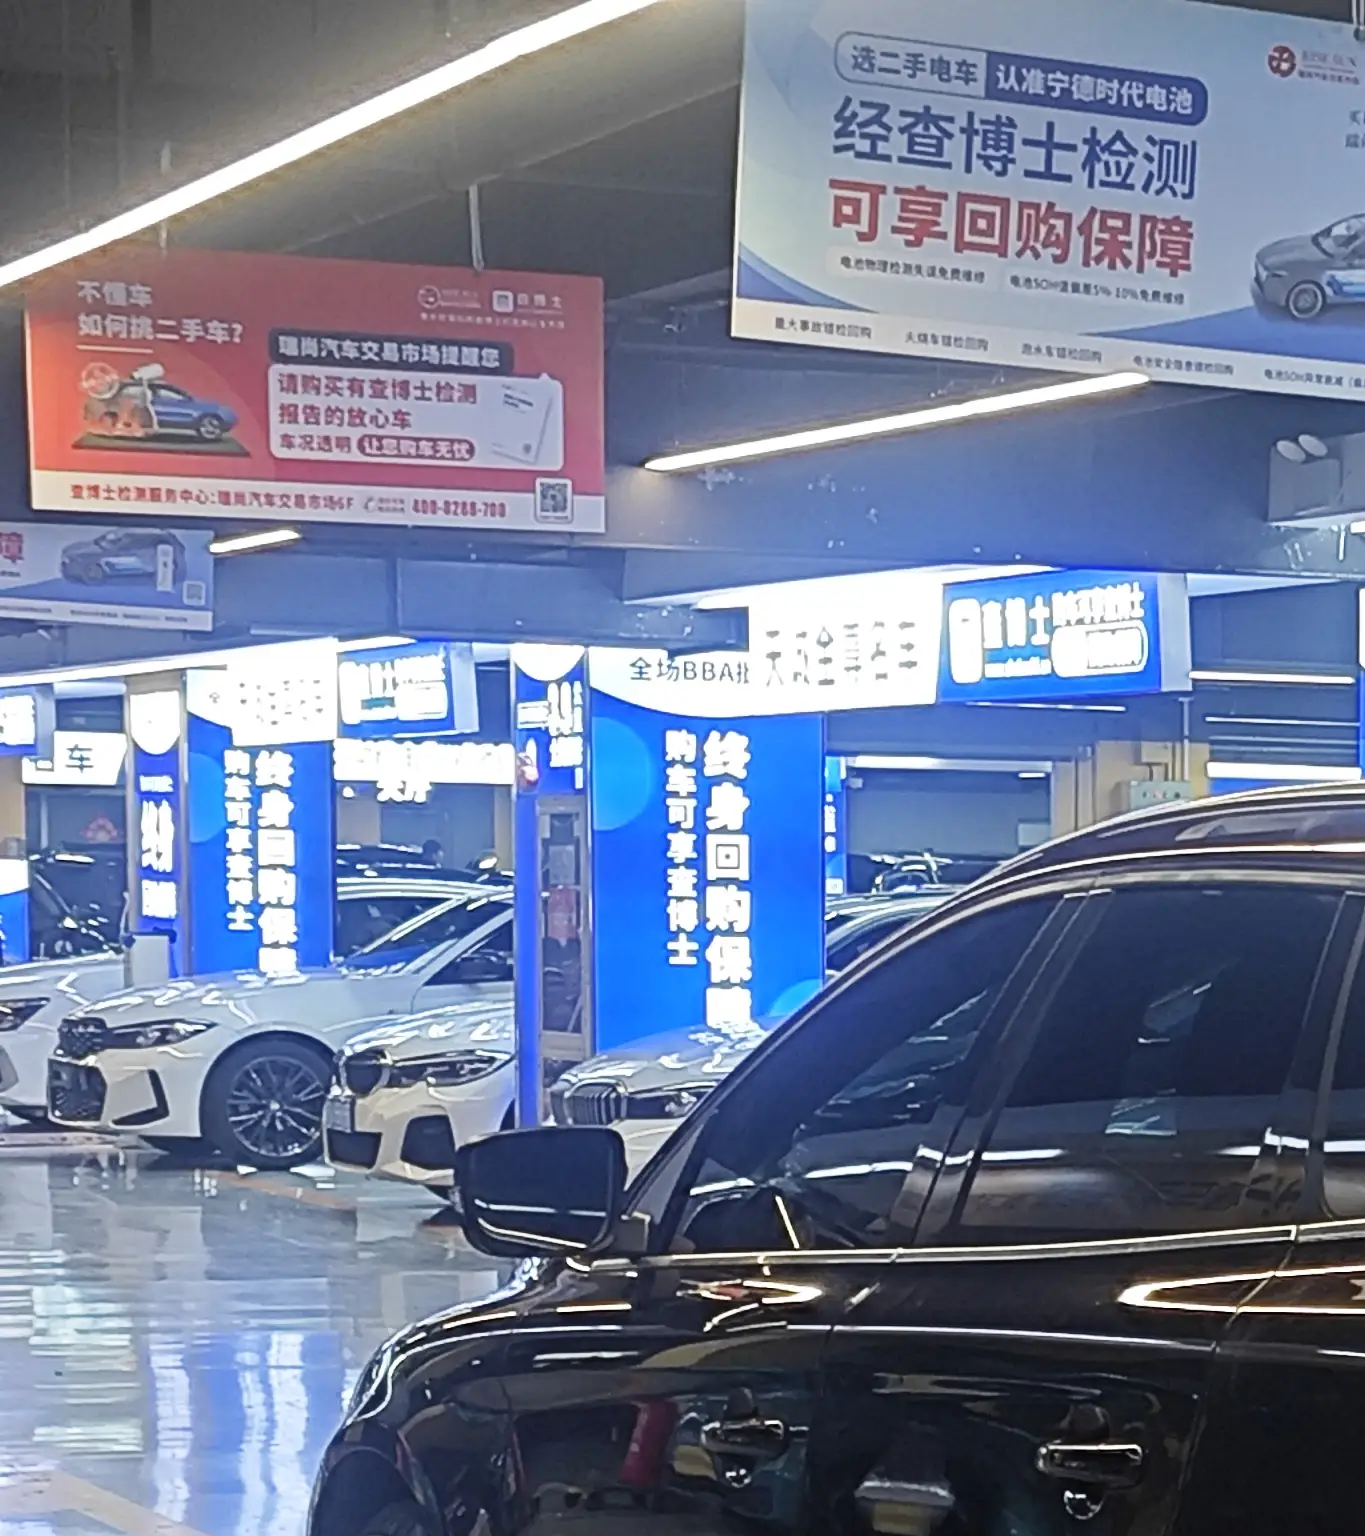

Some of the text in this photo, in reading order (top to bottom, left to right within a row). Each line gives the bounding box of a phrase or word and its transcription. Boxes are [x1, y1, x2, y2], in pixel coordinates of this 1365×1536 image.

[851, 45, 1194, 115] 选二手电车 认准宁德时代电池
[832, 96, 1198, 201] 经查博士检测
[829, 178, 1195, 279] 可享回购保障
[76, 280, 154, 308] 不懂车
[278, 373, 478, 405] 请购买有查博士检测
[278, 402, 413, 430] 报告的放心车
[279, 432, 352, 454] 车况透明
